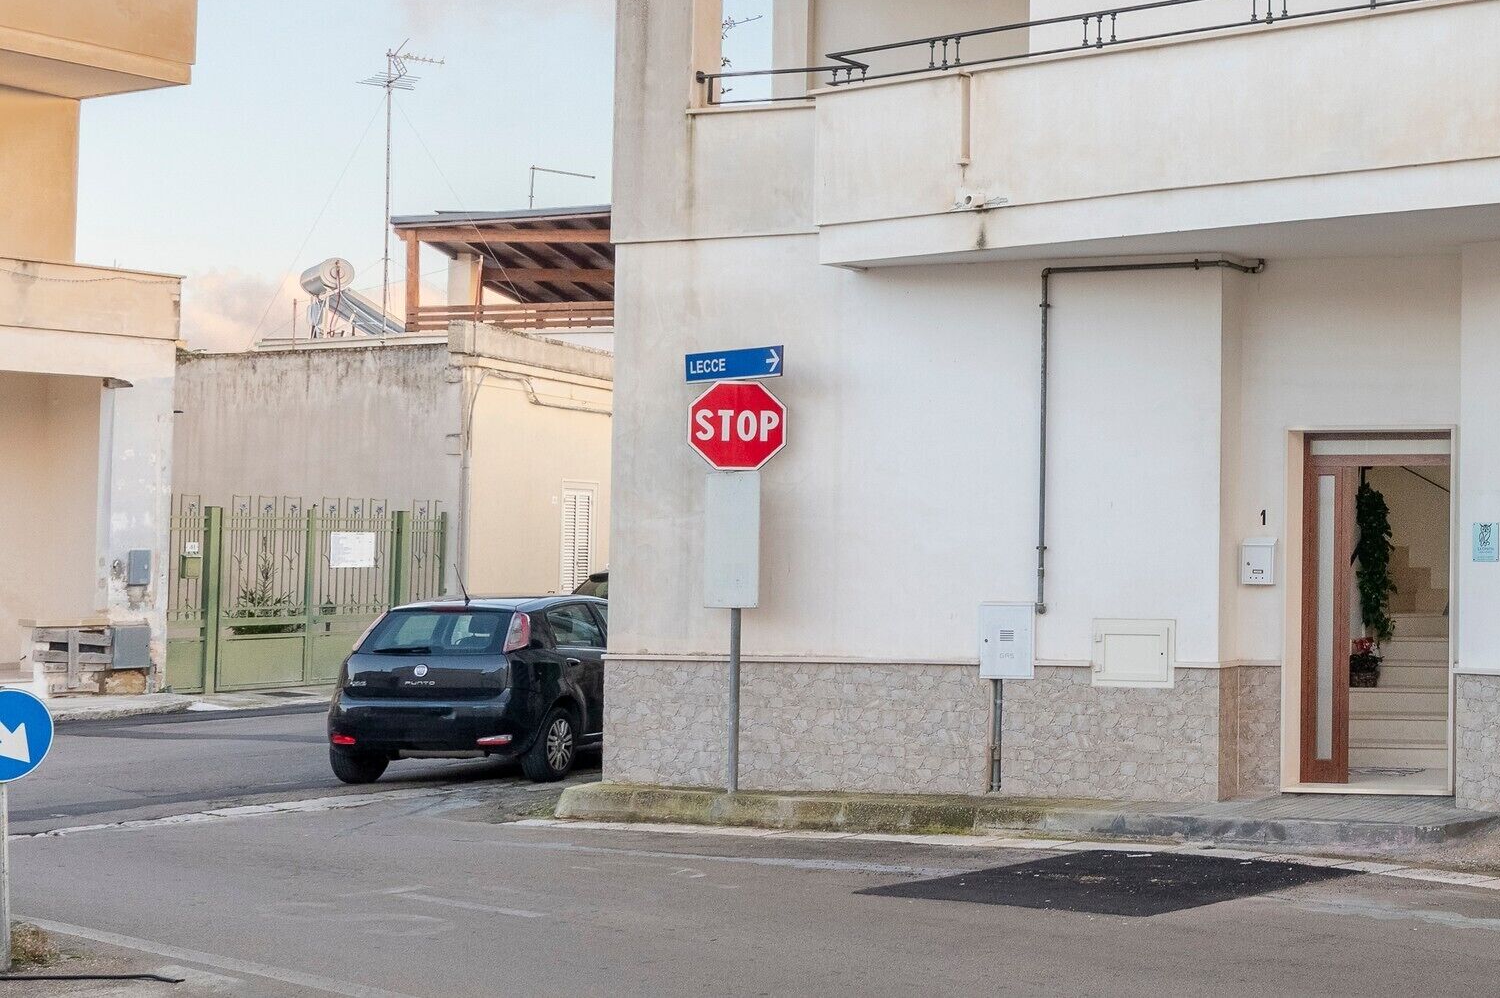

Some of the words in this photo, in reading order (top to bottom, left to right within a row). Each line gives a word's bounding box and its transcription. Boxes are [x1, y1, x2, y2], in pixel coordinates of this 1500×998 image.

[690, 358, 726, 374] LECCE
[695, 409, 779, 441] STOP
[1260, 509, 1266, 525] 1
